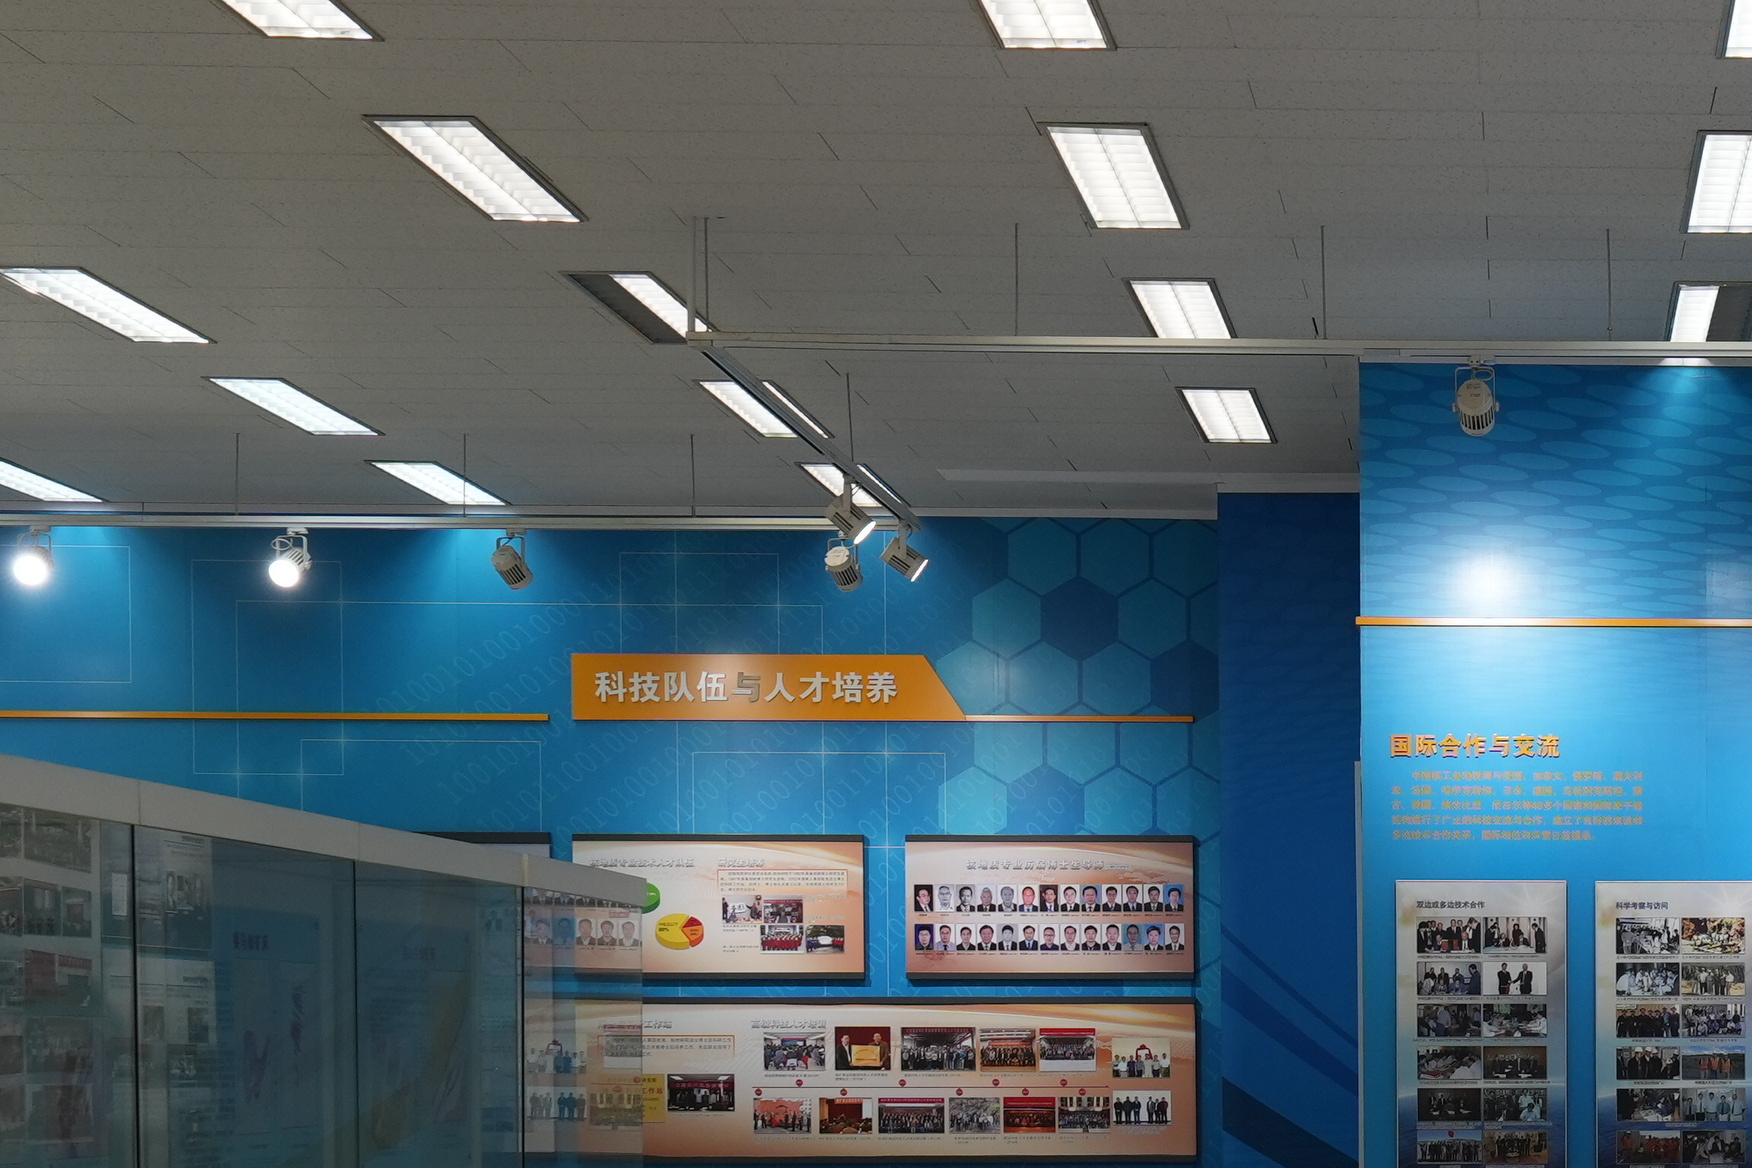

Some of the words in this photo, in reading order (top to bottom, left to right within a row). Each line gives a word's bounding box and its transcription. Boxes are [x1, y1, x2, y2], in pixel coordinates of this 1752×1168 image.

[594, 669, 899, 704] 科技队伍与人才培养
[1389, 733, 1562, 758] 国际合作与交流
